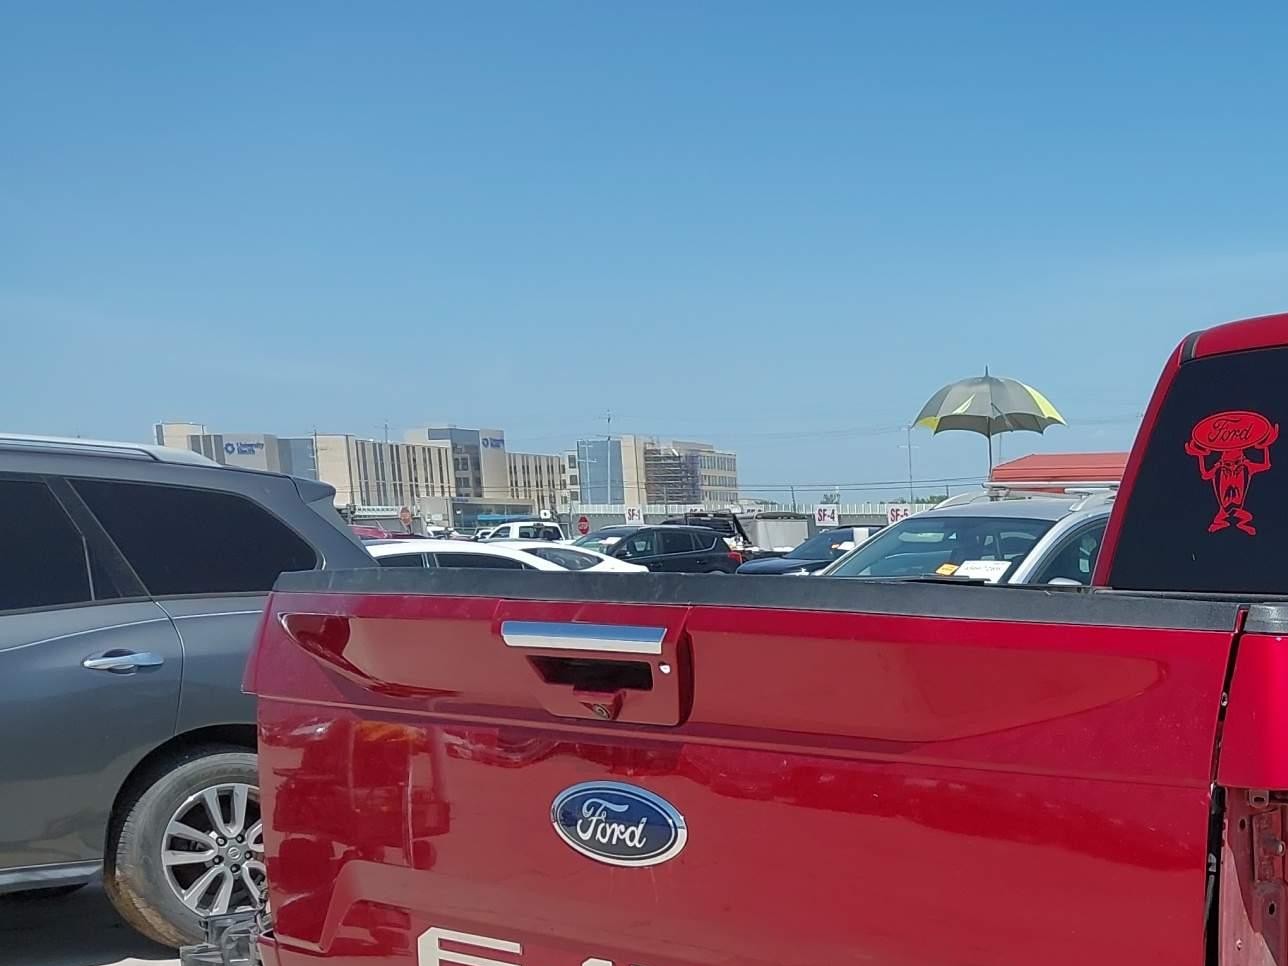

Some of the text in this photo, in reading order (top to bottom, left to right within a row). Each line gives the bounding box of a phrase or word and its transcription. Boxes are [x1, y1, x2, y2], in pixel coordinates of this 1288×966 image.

[1208, 418, 1254, 443] Ford
[817, 508, 836, 522] SF-4
[890, 508, 909, 522] SF-5
[577, 797, 649, 848] Ford
